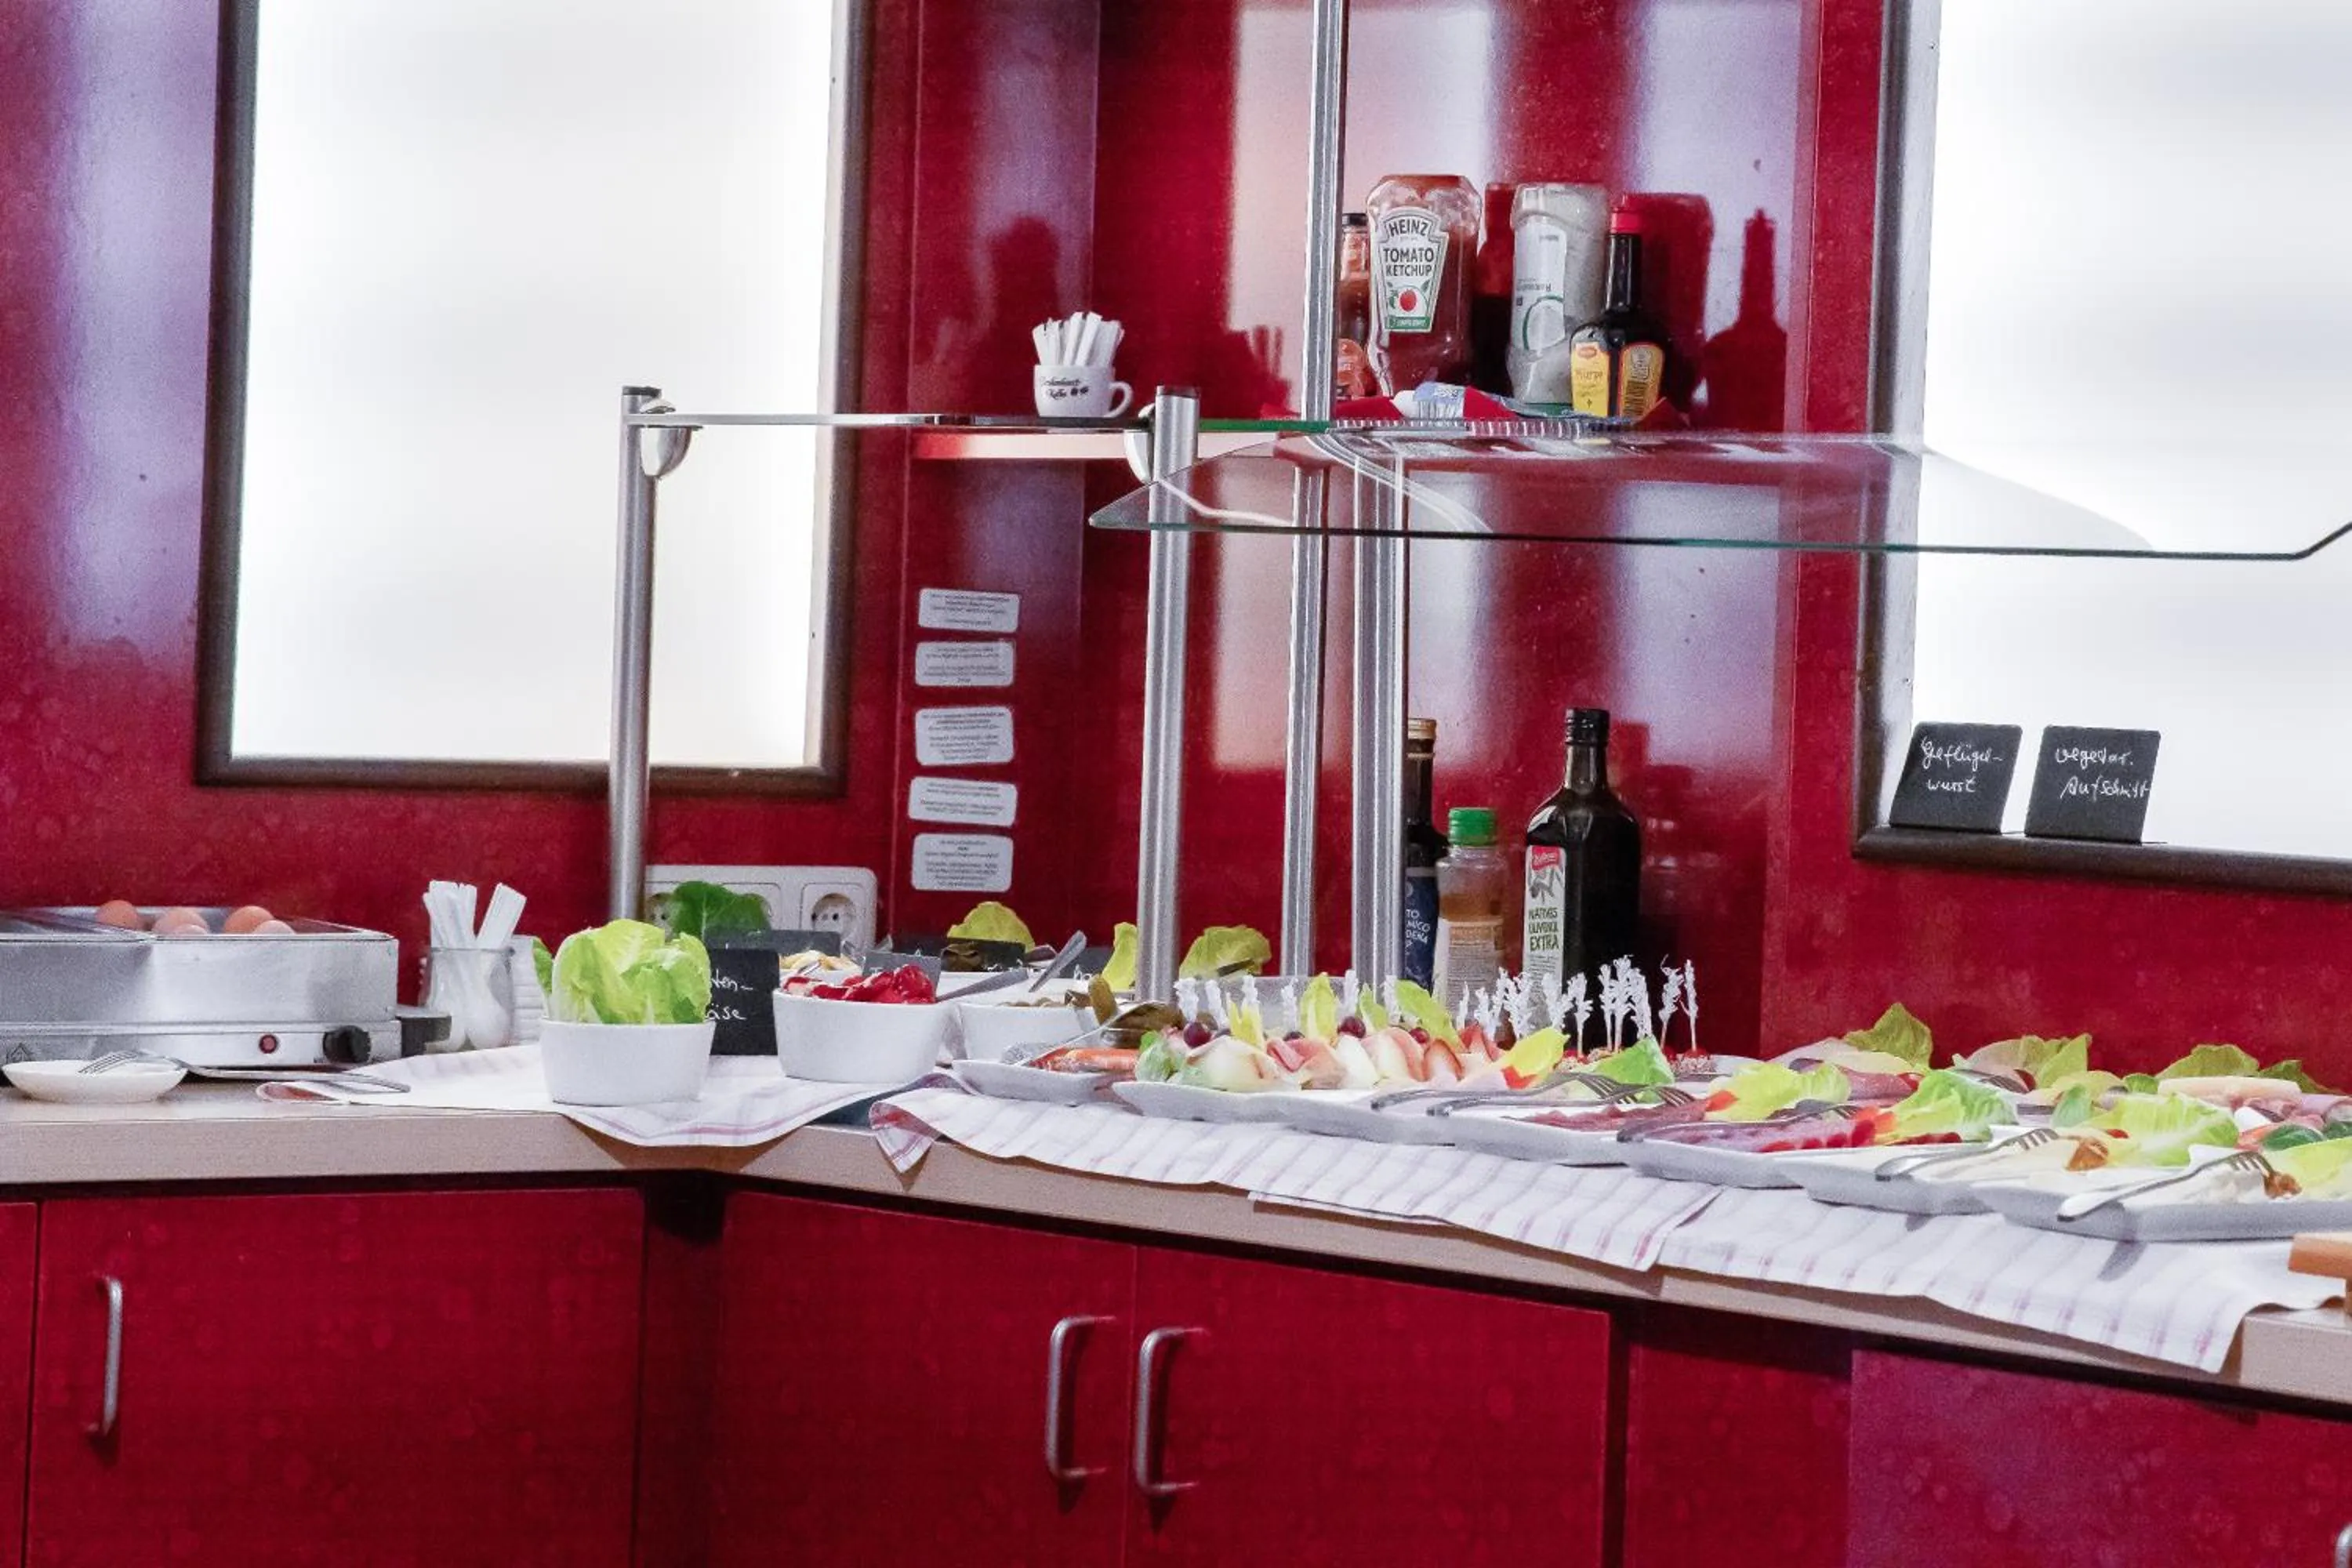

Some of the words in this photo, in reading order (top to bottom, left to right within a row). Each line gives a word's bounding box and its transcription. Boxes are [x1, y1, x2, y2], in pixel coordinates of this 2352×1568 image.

[1388, 219, 1429, 236] HEINZ
[1383, 248, 1435, 263] TOMATO
[1385, 263, 1432, 277] KETCHUP
[1530, 935, 1559, 952] EXTRA
[710, 967, 754, 993] ten-
[705, 1002, 747, 1021] äse
